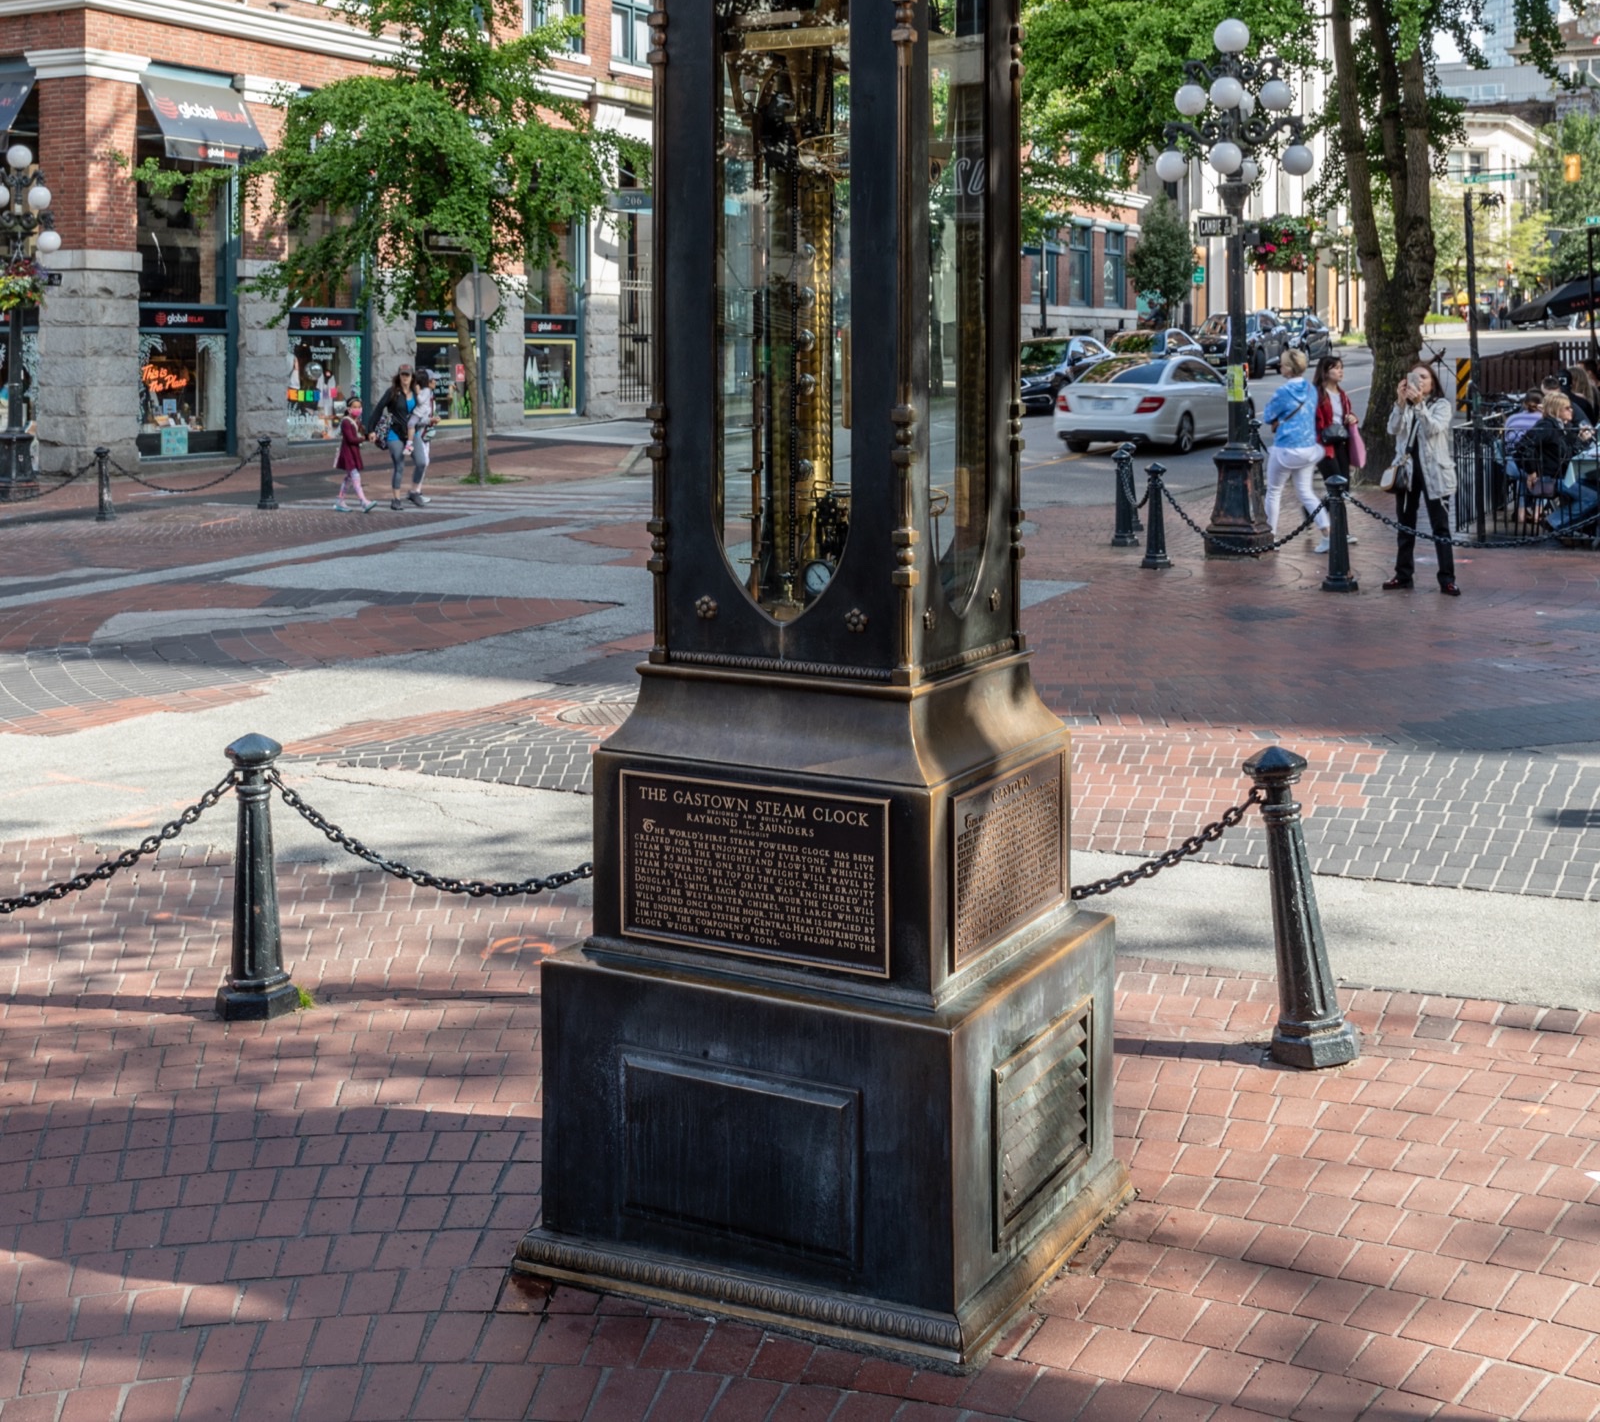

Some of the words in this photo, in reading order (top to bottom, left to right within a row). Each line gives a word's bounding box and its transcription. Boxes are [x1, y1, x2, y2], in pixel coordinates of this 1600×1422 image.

[625, 196, 642, 206] 206
[1201, 219, 1222, 234] CAMBIE
[142, 364, 159, 380] This
[160, 367, 167, 377] is
[165, 375, 187, 389] Place
[639, 786, 667, 802] THE
[673, 790, 748, 812] GASTOWN
[756, 800, 805, 819] STEAM
[813, 807, 869, 827] CLOCK
[707, 810, 739, 818] DESIGNED
[687, 813, 738, 827] RAYMOND
[746, 821, 754, 829] L.
[759, 823, 814, 837] SAUNDERS
[730, 829, 769, 838] HOROLOGIST
[635, 833, 670, 844] CREATED
[693, 841, 709, 849] THE
[712, 844, 760, 856] ENJOYMENT
[779, 853, 828, 865] EVERYONE.
[834, 861, 850, 869] THE
[855, 864, 874, 872] LIVE
[635, 842, 660, 851] STEAM
[665, 846, 692, 855] WINDS
[695, 850, 710, 858] THE
[715, 853, 751, 864] WEIGHTS
[755, 858, 773, 867] AND
[778, 861, 806, 871] BLOWS
[810, 866, 826, 874] THE
[831, 869, 876, 881] WHISTLES.
[669, 829, 704, 840] WORLD'S
[706, 834, 727, 843] FIRST
[730, 837, 755, 847] STEAM
[759, 841, 798, 853] POWERED
[802, 847, 830, 857] CLOCK
[834, 851, 849, 860] HAS
[853, 854, 874, 863] BEEN
[635, 850, 660, 859] EVERY
[678, 856, 712, 867] MINUTES
[716, 861, 733, 870] ONE
[737, 864, 761, 874] STEEL
[765, 868, 799, 879] WEIGHT
[803, 873, 824, 883] WILL
[827, 877, 860, 888] TRAVEL
[863, 882, 874, 890] BY
[635, 858, 660, 868] STEAM
[664, 862, 692, 872] POWER
[708, 868, 722, 877] THE
[727, 871, 741, 879] TOP
[758, 876, 775, 884] THE
[778, 879, 810, 889] CLOCK.
[814, 884, 830, 892] THE
[835, 887, 875, 899] GRAVITY
[635, 866, 666, 876] DRIVEN
[741, 881, 768, 891] DRIVE
[775, 886, 793, 895] WAS
[863, 899, 874, 907] BY
[635, 883, 662, 893] SOUND
[666, 888, 681, 896] THE
[686, 891, 743, 905] WESTMINSTER
[748, 900, 780, 911] CHIMES.
[785, 906, 801, 914] THE
[805, 908, 832, 919] LARGE
[837, 913, 875, 925] WHISTLE
[635, 891, 654, 900] WILL
[658, 895, 683, 905] SOUND
[686, 899, 707, 908] ONCE
[711, 903, 722, 911] ON
[726, 905, 740, 914] THE
[743, 908, 767, 918] HOUR.
[769, 912, 784, 921] THE
[787, 915, 812, 925] STEAM
[824, 921, 861, 933] SUPPLIED
[864, 927, 875, 935] BY
[636, 900, 650, 908] THE
[653, 903, 710, 918] UNDERGROUND
[712, 912, 740, 922] SYSTEM
[675, 880, 682, 888] L.
[684, 881, 712, 892] SMITH.
[716, 886, 736, 896] EACH
[739, 889, 775, 902] QUARTER
[779, 895, 801, 905] HOUR
[803, 899, 818, 908] THE
[822, 902, 851, 913] CLOCK
[854, 906, 874, 916] WILL
[635, 908, 672, 920] LIMITED.
[676, 915, 691, 923] THE
[696, 918, 744, 932] COMPONENT
[751, 927, 774, 937] PARTS
[779, 931, 801, 941] COST
[837, 941, 856, 950] AND
[860, 944, 875, 953] THE
[635, 917, 662, 927] CLOCK
[667, 922, 699, 933] WEIGHS
[704, 928, 726, 938] OVER
[731, 932, 750, 941] TWO
[754, 936, 780, 946] TONS.
